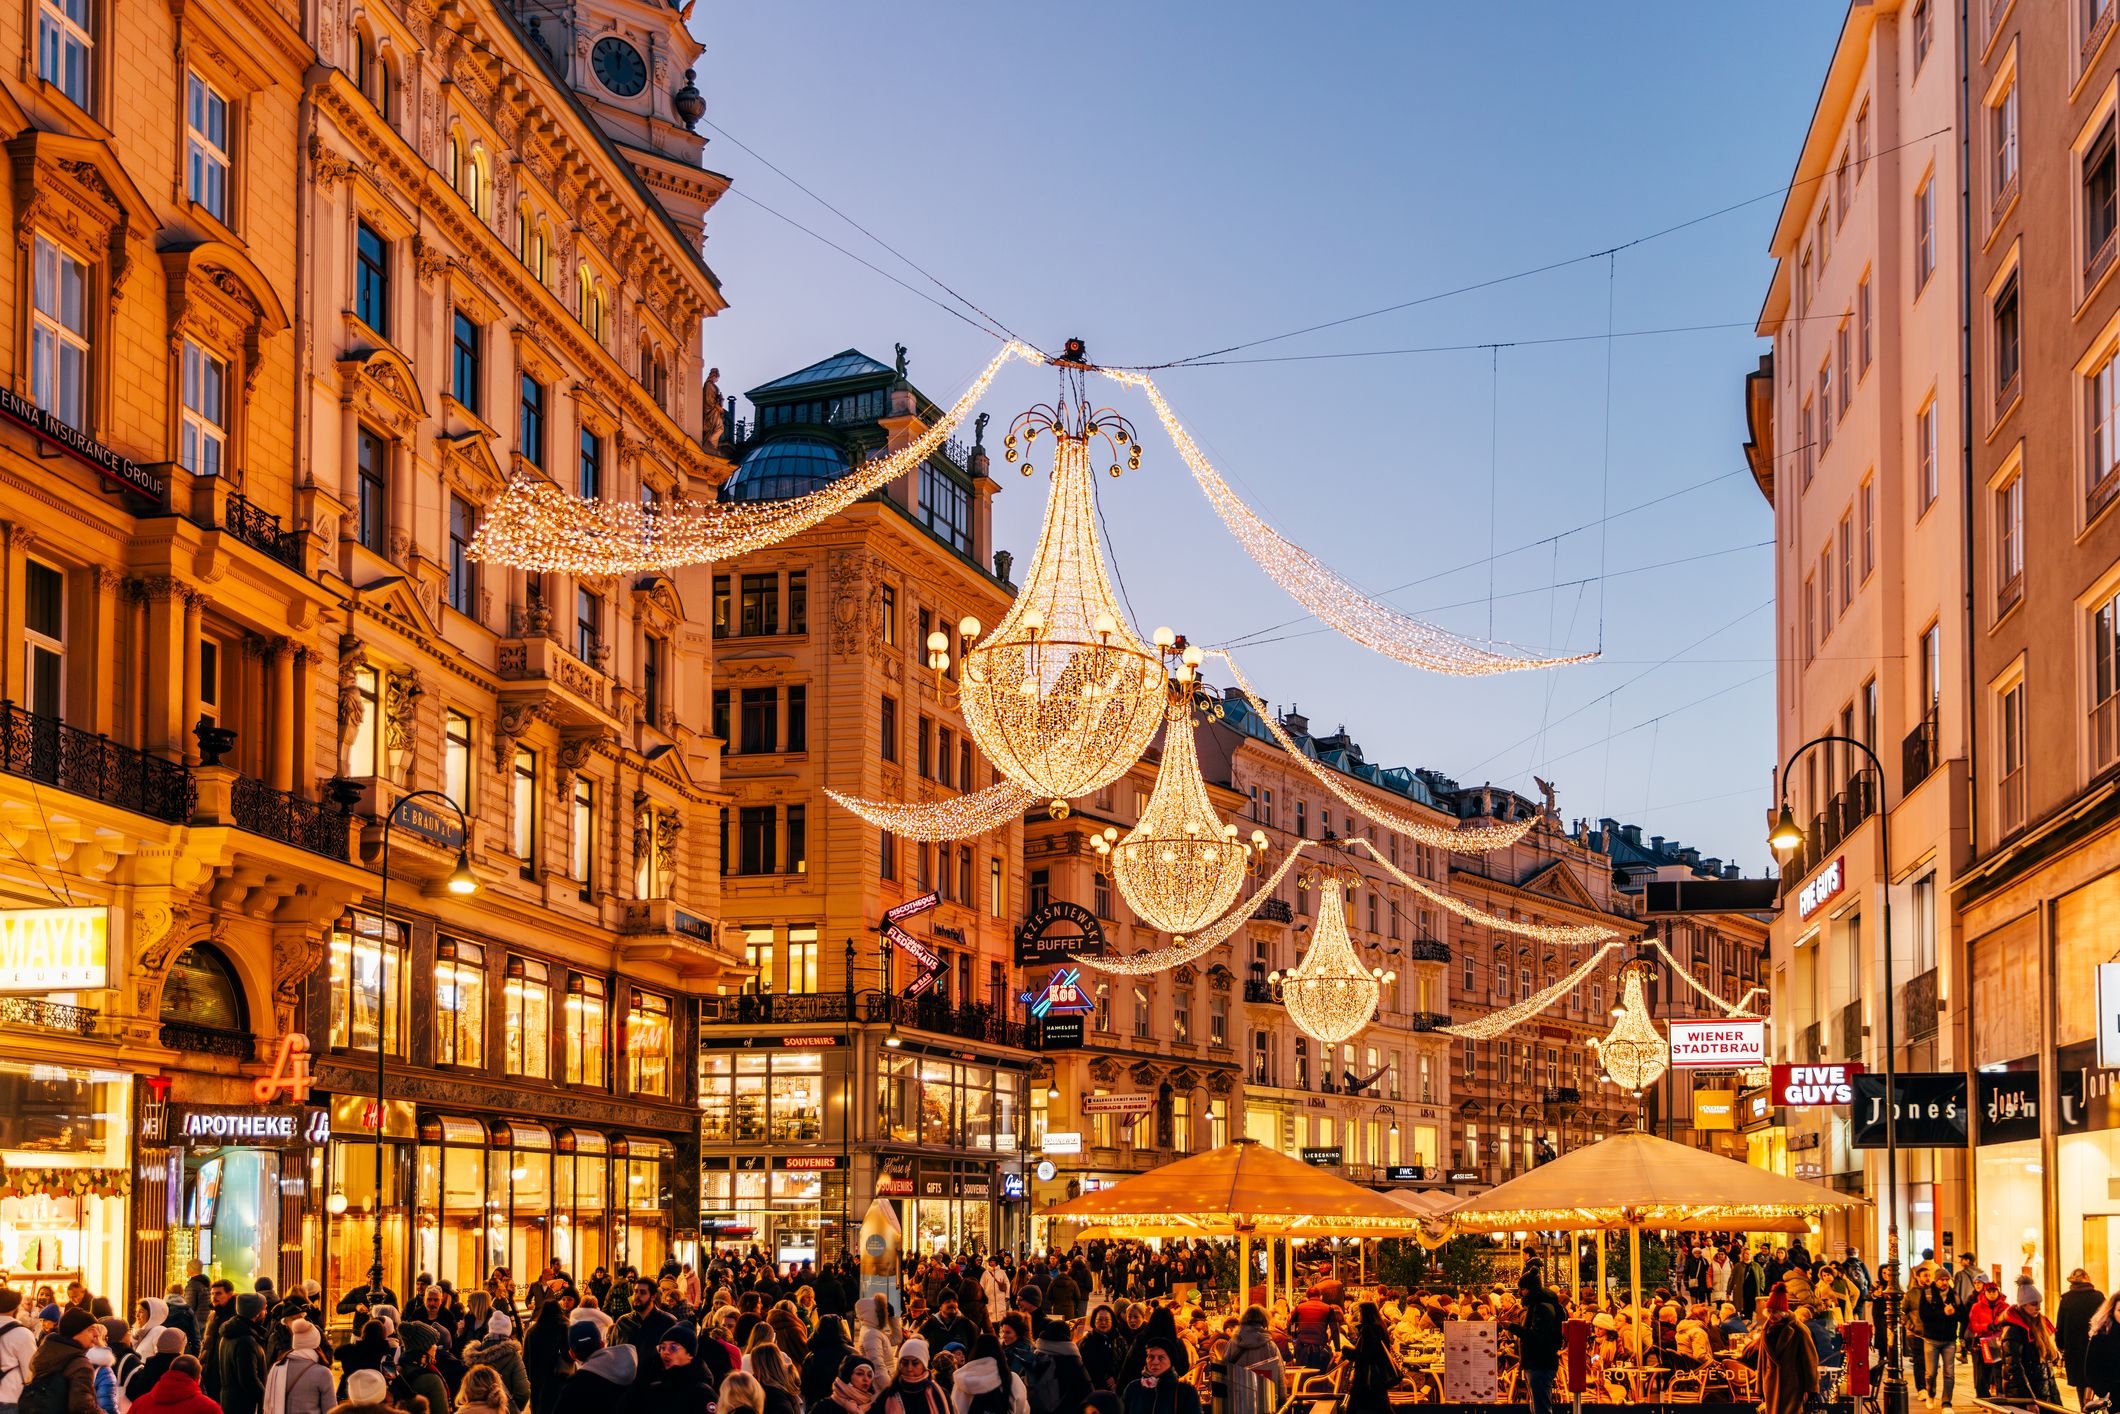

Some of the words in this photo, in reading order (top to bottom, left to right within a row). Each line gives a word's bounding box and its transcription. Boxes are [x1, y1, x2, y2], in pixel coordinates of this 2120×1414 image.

[45, 410, 119, 471] INSURANCE
[123, 457, 164, 496] GROUP
[412, 809, 440, 833] BRAUN
[1799, 880, 1817, 918] FIVE
[1816, 861, 1839, 905] GUYS
[888, 893, 937, 917] DISCOTHEQUE
[887, 927, 939, 970] FLEDERMAUS
[1037, 938, 1083, 951] BUFFET
[917, 973, 933, 988] BAR
[783, 1037, 835, 1046] SOUVENIRS
[1688, 1031, 1744, 1041] WIENER
[1673, 1043, 1759, 1054] STADTBRÄU
[1791, 1067, 1845, 1084] FIVE
[1784, 1085, 1852, 1103] GUYS
[2080, 1067, 2120, 1109] Jone
[188, 1114, 294, 1137] APOTHEKE
[787, 1158, 835, 1167] SOUVENIRS
[881, 1181, 914, 1192] SOUVENIRS
[926, 1182, 942, 1194] GIFTS
[954, 1183, 959, 1194] &
[963, 1184, 989, 1194] SOUVENIRS
